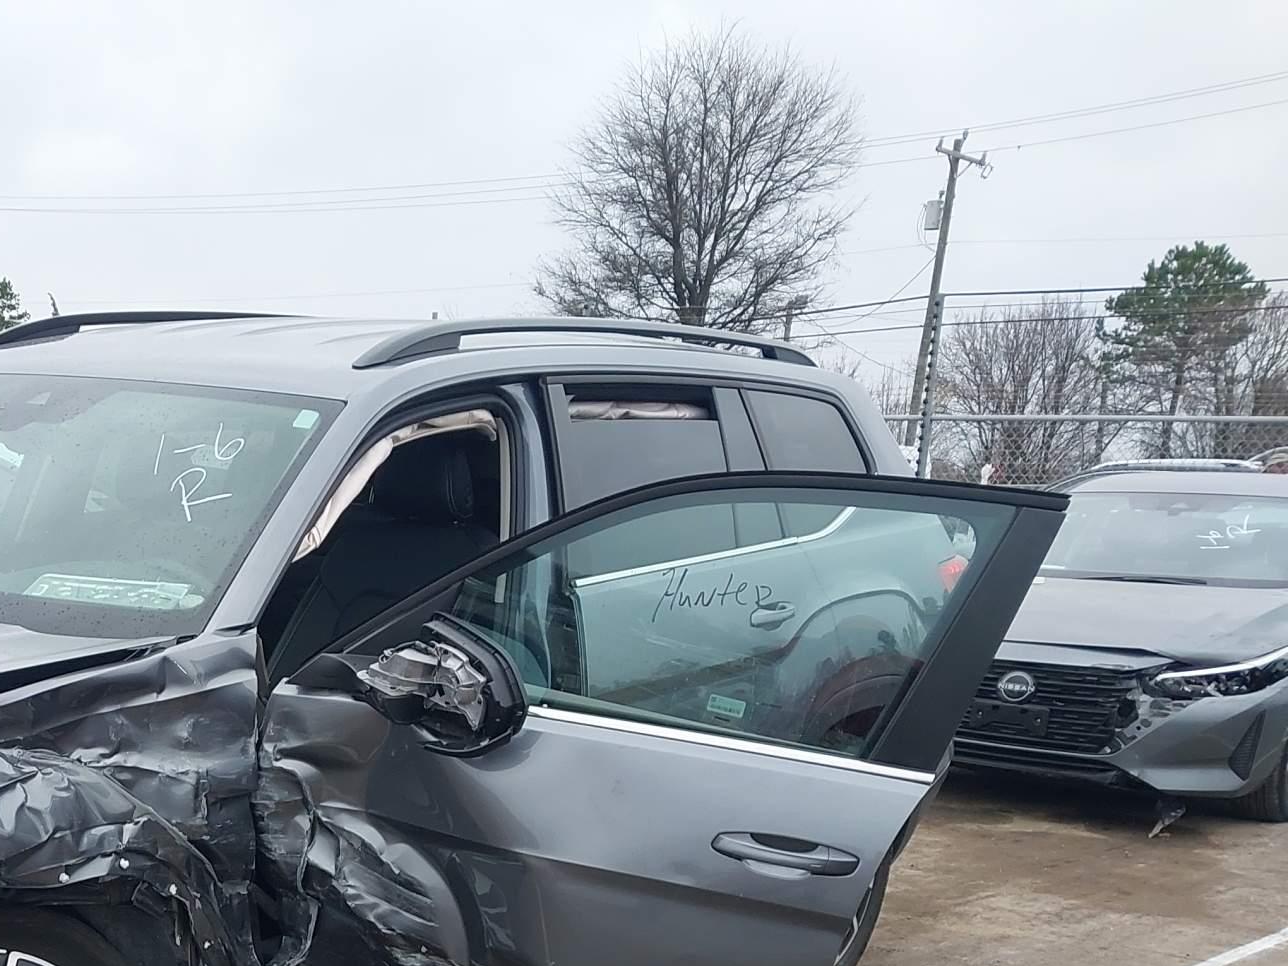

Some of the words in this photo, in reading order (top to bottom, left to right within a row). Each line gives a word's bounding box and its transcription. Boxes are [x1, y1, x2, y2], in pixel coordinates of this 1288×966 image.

[153, 422, 245, 475] 1-6
[169, 466, 233, 522] R
[998, 682, 1036, 692] NISSAN
